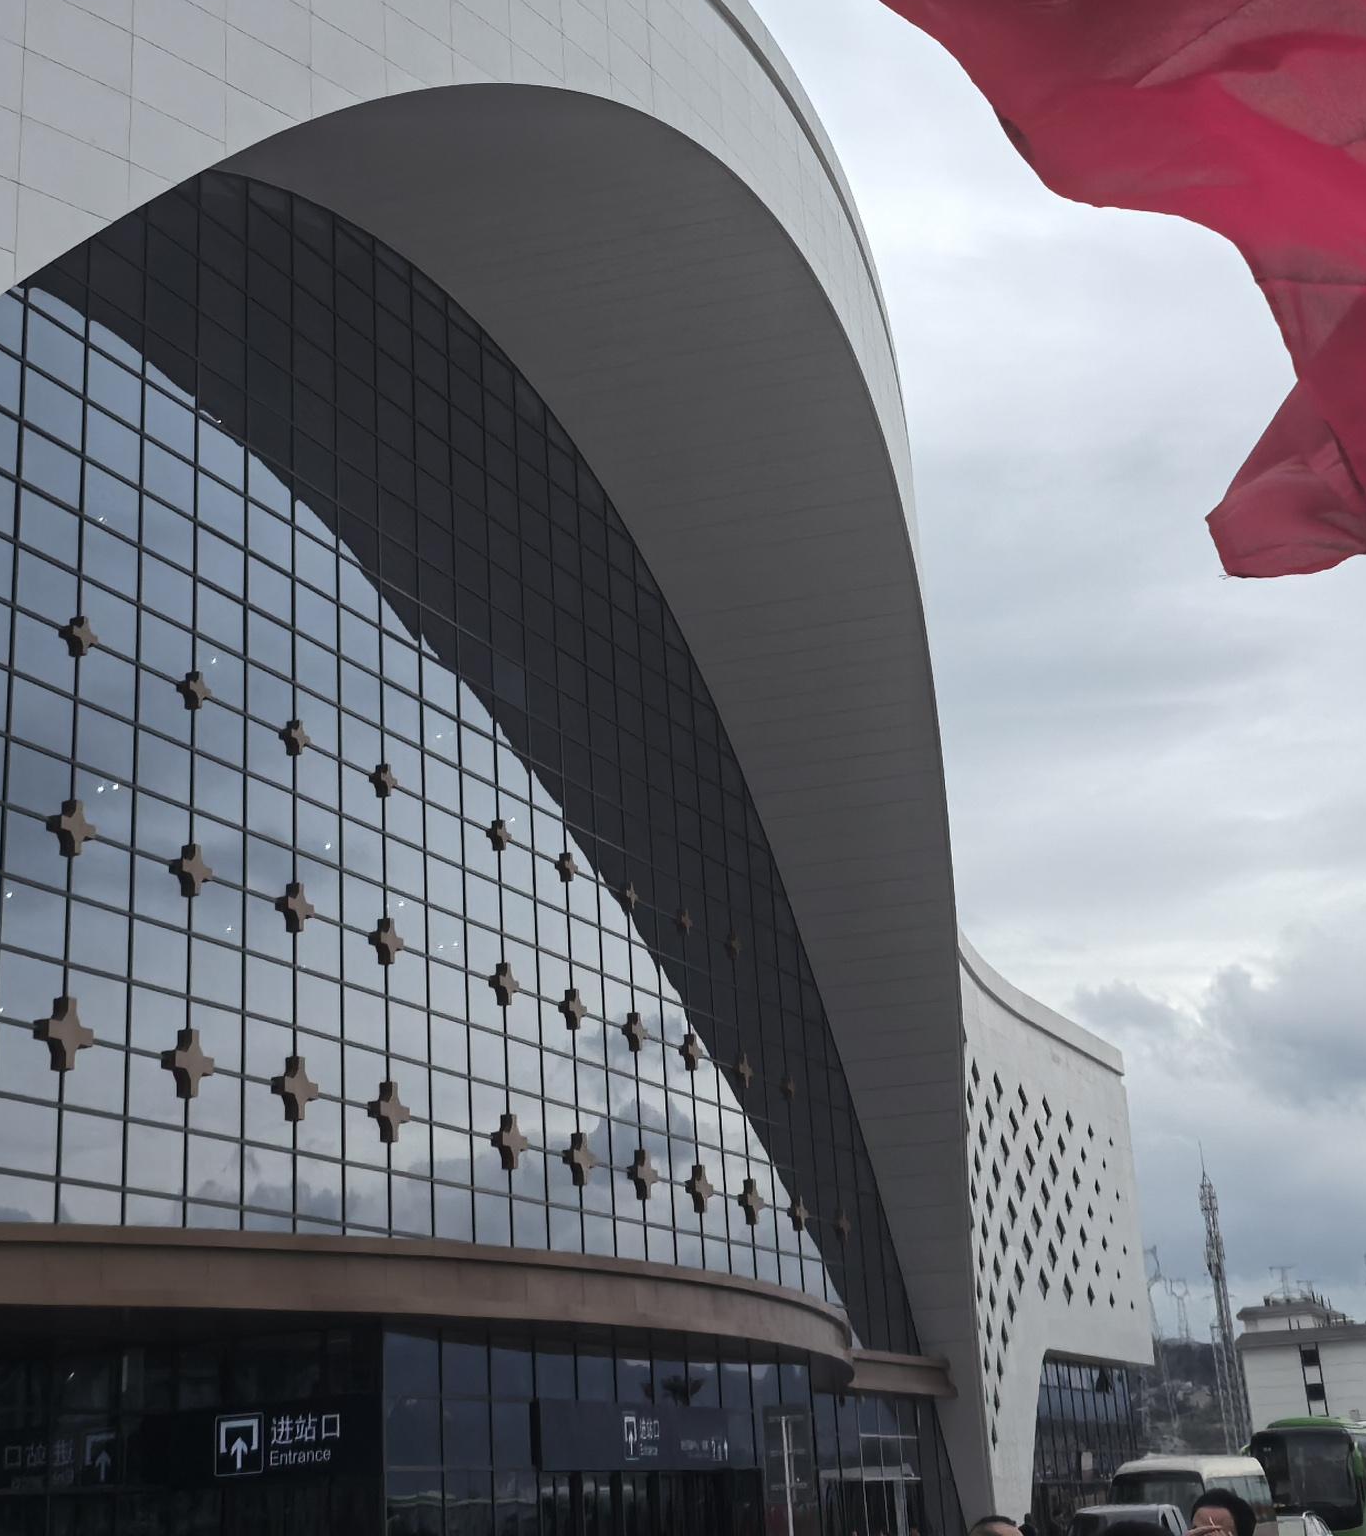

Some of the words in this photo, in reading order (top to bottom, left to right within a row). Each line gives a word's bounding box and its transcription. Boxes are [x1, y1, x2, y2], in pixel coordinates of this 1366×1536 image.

[270, 1412, 341, 1445] 进站口
[269, 1448, 332, 1467] Entrance
